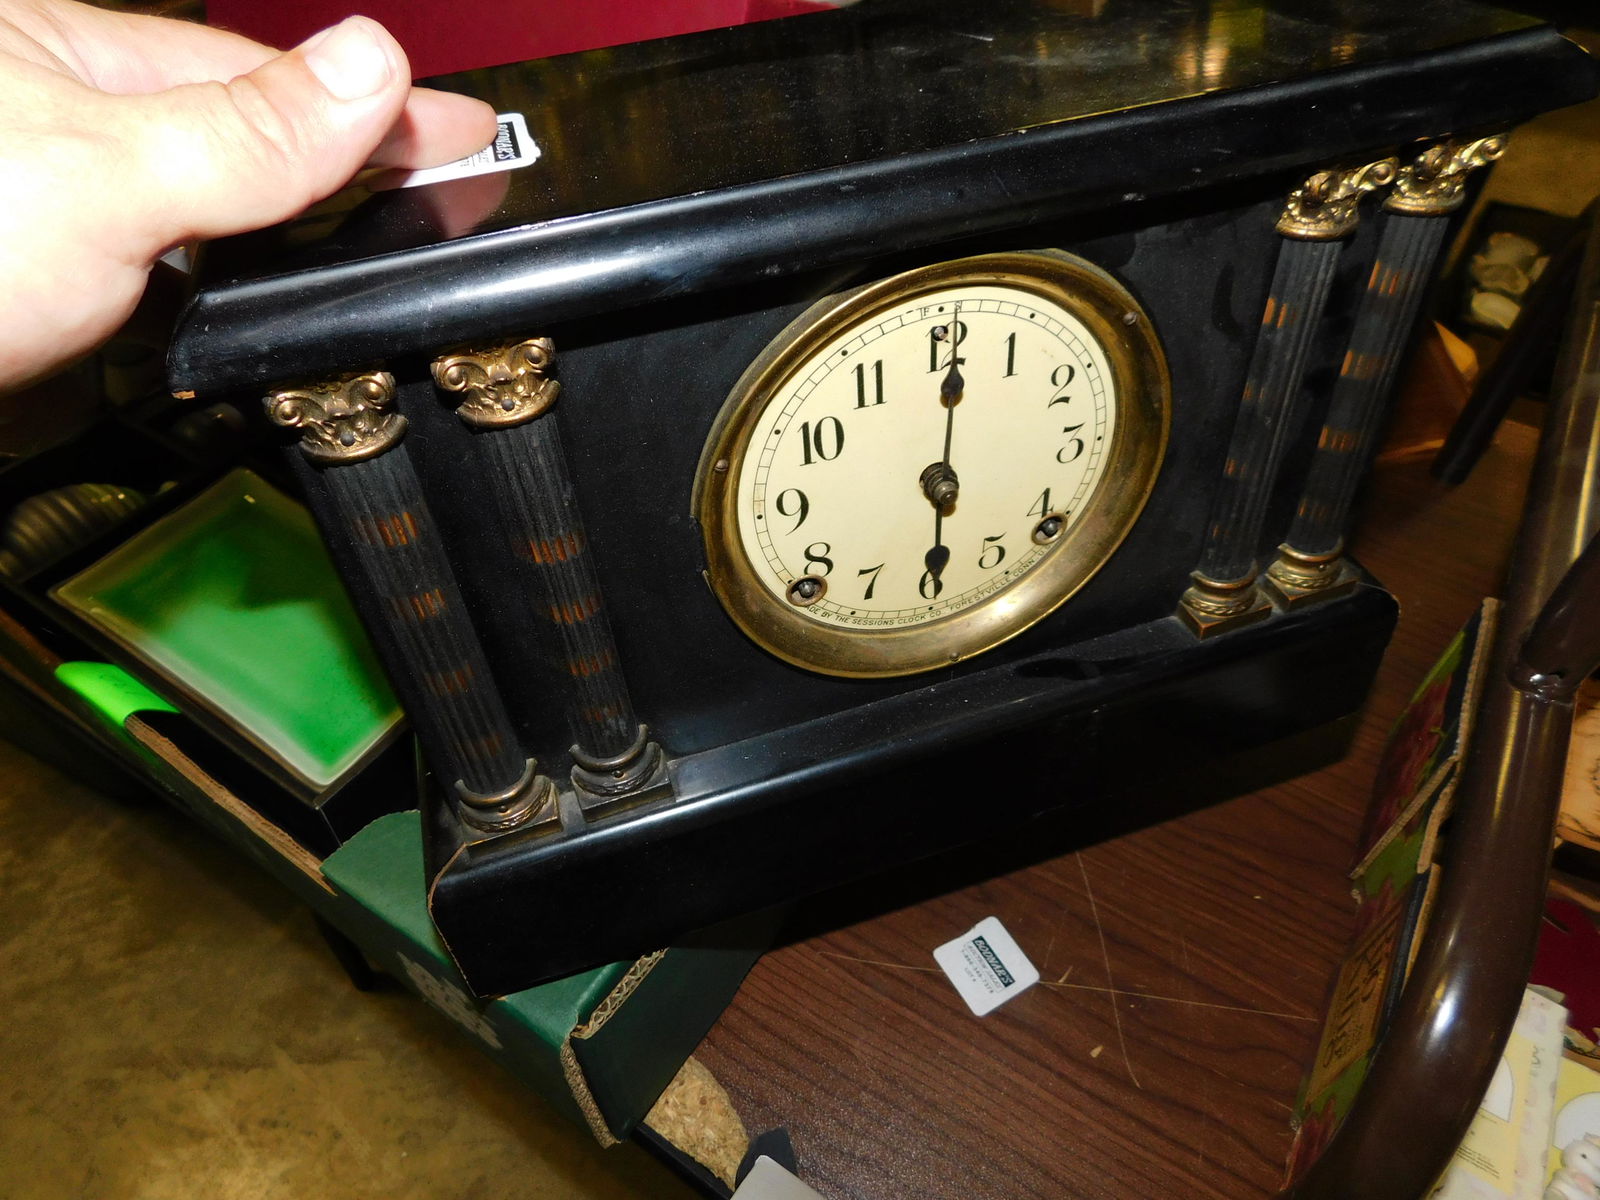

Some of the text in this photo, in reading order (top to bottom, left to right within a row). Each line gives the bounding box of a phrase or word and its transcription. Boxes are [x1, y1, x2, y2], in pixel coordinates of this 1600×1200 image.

[925, 320, 967, 374] 12
[1002, 332, 1019, 378] 1
[851, 359, 887, 410] 11
[1047, 364, 1075, 409] 2
[797, 416, 845, 466] 10
[1056, 422, 1086, 464] 3
[776, 488, 809, 536] 9
[1026, 487, 1054, 518] 4
[803, 541, 834, 577] 8
[978, 532, 1007, 570] 5
[820, 611, 832, 619] BY
[835, 614, 850, 624] THE
[851, 618, 895, 627] SESSIONS
[897, 614, 928, 625] CLOCK
[949, 577, 1011, 611] FORESTVILLE
[858, 563, 886, 600] 7
[919, 564, 943, 600] 6
[974, 939, 1013, 985] BODNAR'S
